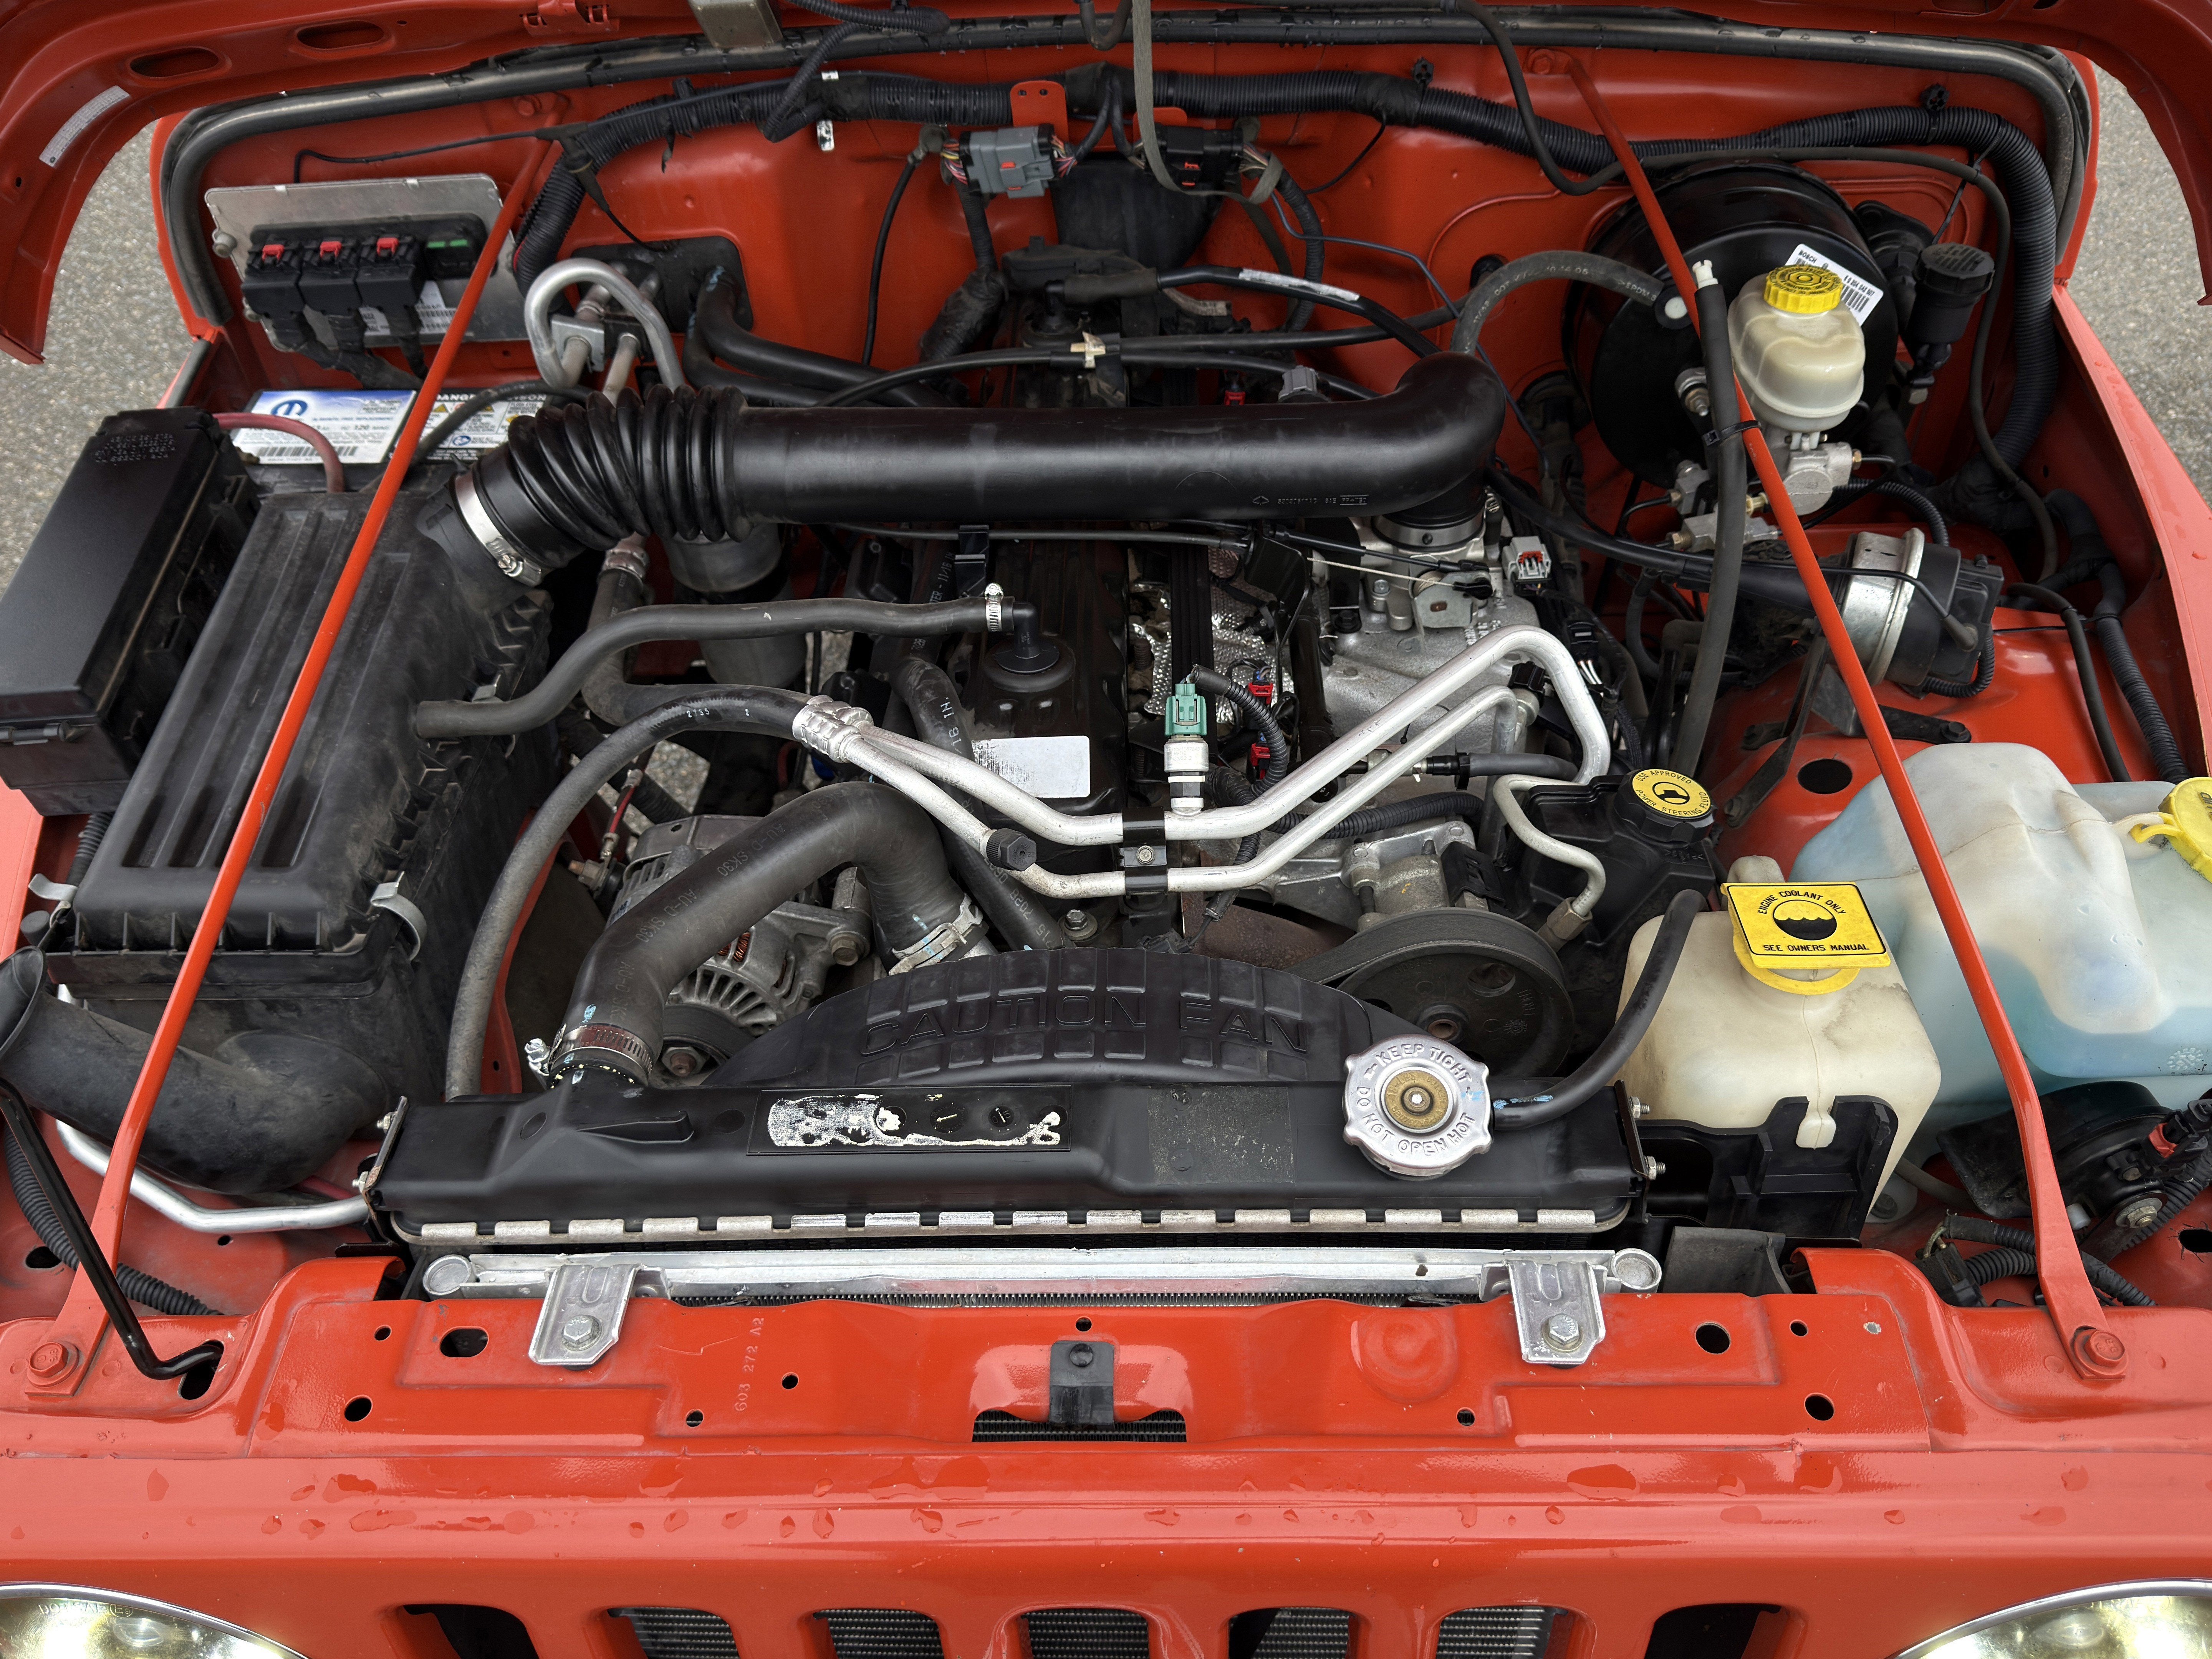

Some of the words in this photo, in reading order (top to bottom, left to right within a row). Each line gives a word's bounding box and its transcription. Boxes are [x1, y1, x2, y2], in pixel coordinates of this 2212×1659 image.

[1797, 250, 1818, 264] BOSCH
[940, 697, 955, 719] IN.
[948, 726, 962, 754] /16
[1636, 772, 1649, 782] USE
[1650, 770, 1692, 785] APPROVED
[1636, 790, 1657, 807] POWER
[1661, 807, 1702, 816] STEERING
[1699, 792, 1709, 810] FLUID
[1758, 894, 1779, 915] ENGINE
[1779, 890, 1823, 901] COOLANT
[1825, 900, 1847, 915] ONLY
[859, 995, 1147, 1057] CAUTION
[1178, 1001, 1308, 1054] FAN
[1376, 1043, 1425, 1067] KEEP
[1429, 1046, 1473, 1083] TIGHT
[1356, 1086, 1371, 1107] DO
[1362, 1113, 1396, 1143] NOT
[1447, 1112, 1476, 1144] HOT
[1397, 1139, 1450, 1157] OPEN
[734, 1383, 750, 1412] 603
[742, 1345, 758, 1373] 272
[750, 1317, 765, 1336] A2
